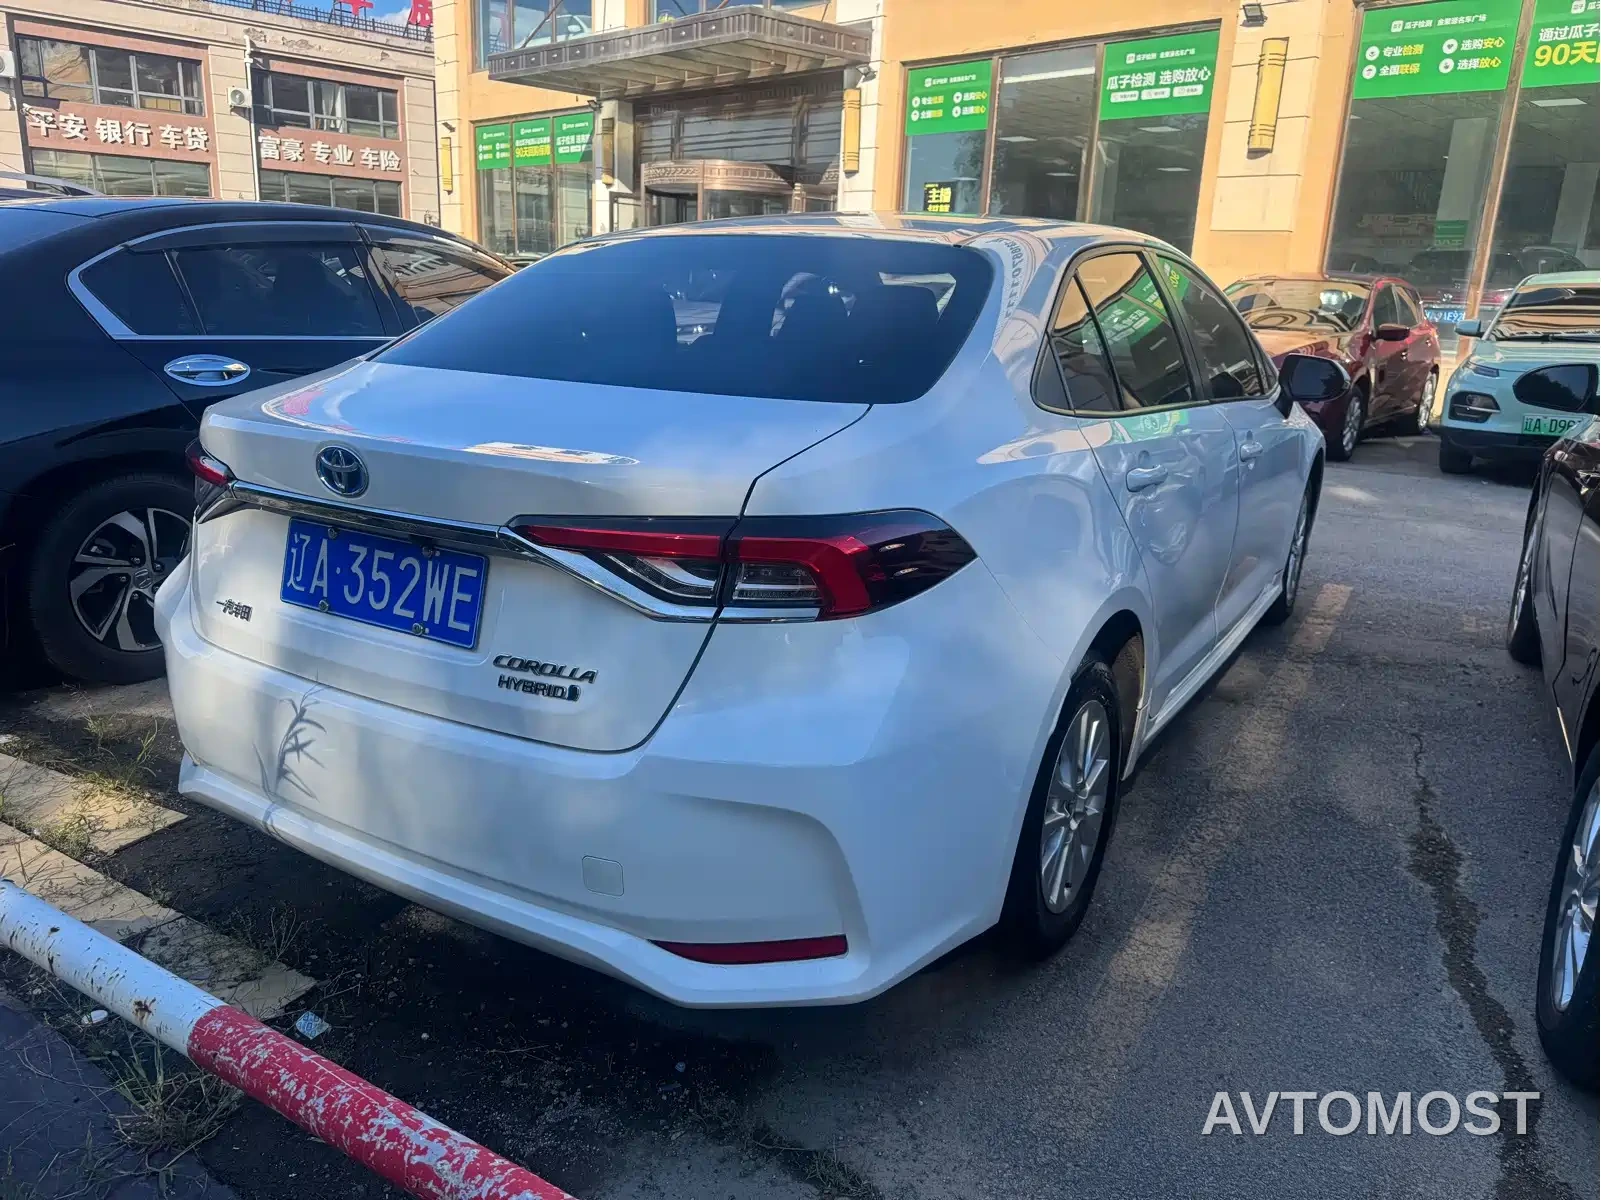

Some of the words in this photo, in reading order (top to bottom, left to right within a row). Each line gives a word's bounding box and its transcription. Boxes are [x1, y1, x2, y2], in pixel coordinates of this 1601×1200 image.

[1461, 37, 1505, 51] 选购安心
[1538, 23, 1600, 42] 通过瓜子
[1382, 44, 1424, 58] 专业检测
[1534, 40, 1600, 67] 90天
[1378, 63, 1420, 77] 全国联保
[1456, 57, 1501, 71] 选择放心
[1106, 71, 1156, 90] 瓜子检测
[1159, 66, 1211, 85] 选购放心
[29, 109, 88, 141] 平安
[95, 117, 152, 146] 银行
[159, 124, 210, 153] 车贷
[258, 134, 304, 163] 富豪
[310, 141, 354, 167] 专业
[360, 146, 401, 172] 车险
[493, 653, 599, 684] COROLLA
[497, 674, 565, 700] HYBRID
